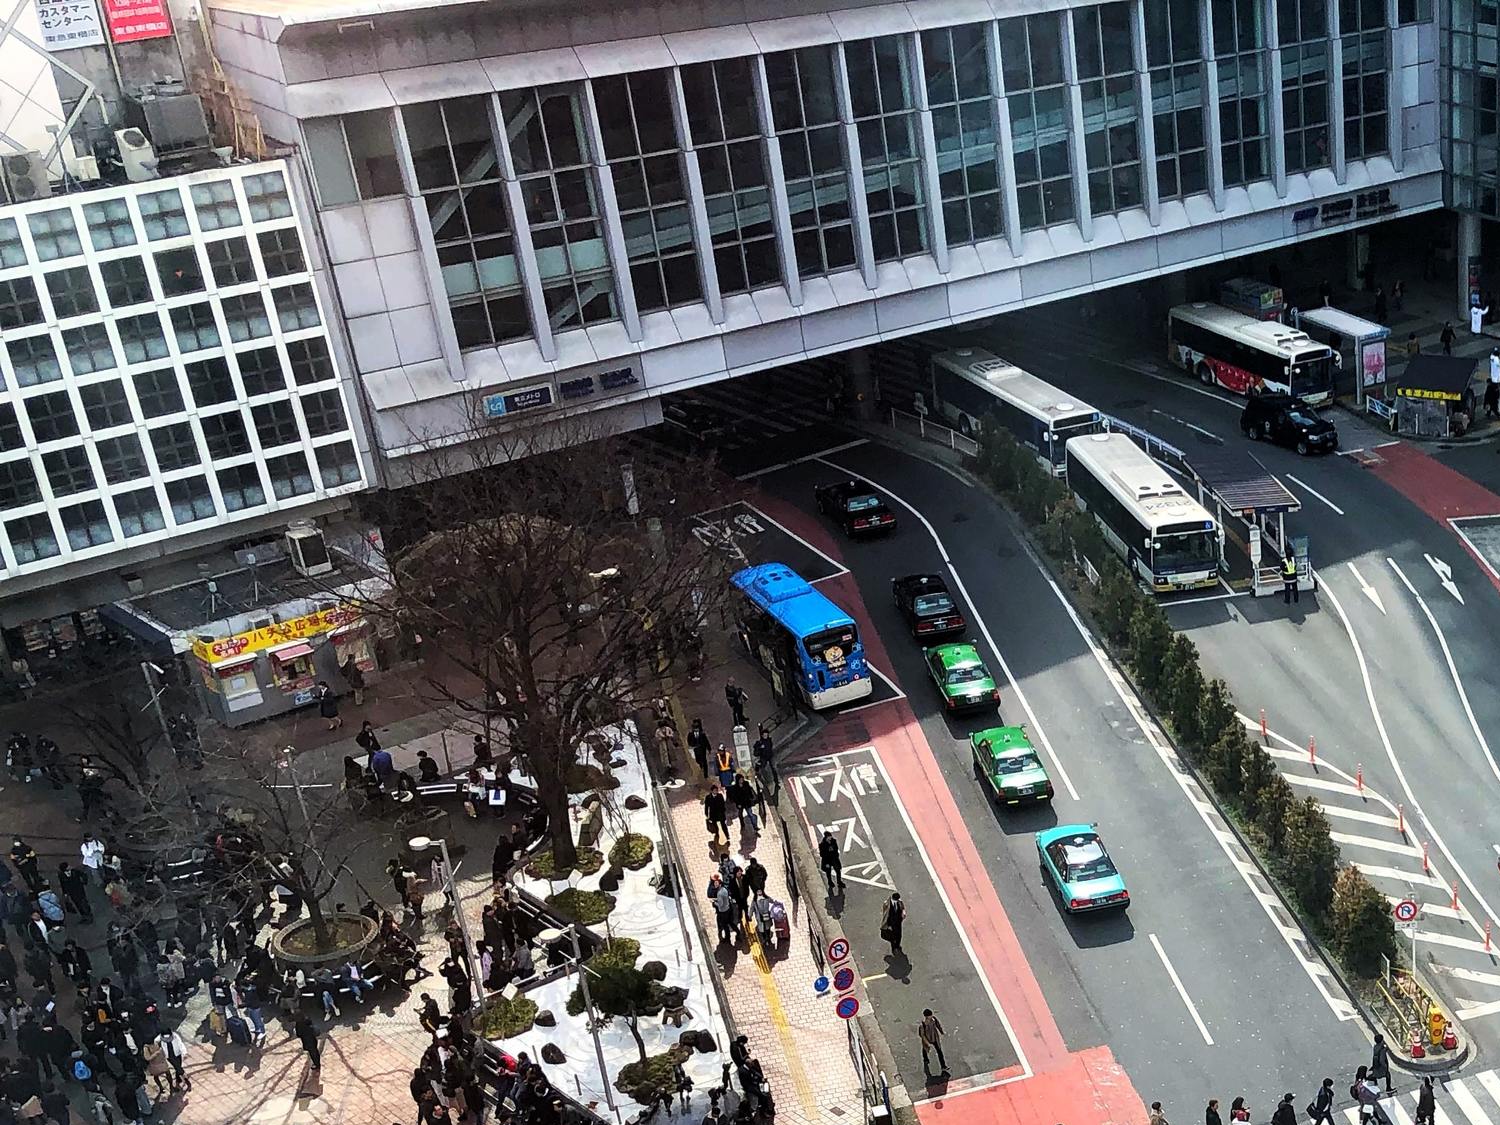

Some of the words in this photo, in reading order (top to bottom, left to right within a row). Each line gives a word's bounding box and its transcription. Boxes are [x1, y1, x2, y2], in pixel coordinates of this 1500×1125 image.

[39, 5, 91, 19] カスタマー
[41, 15, 94, 29] センターへ
